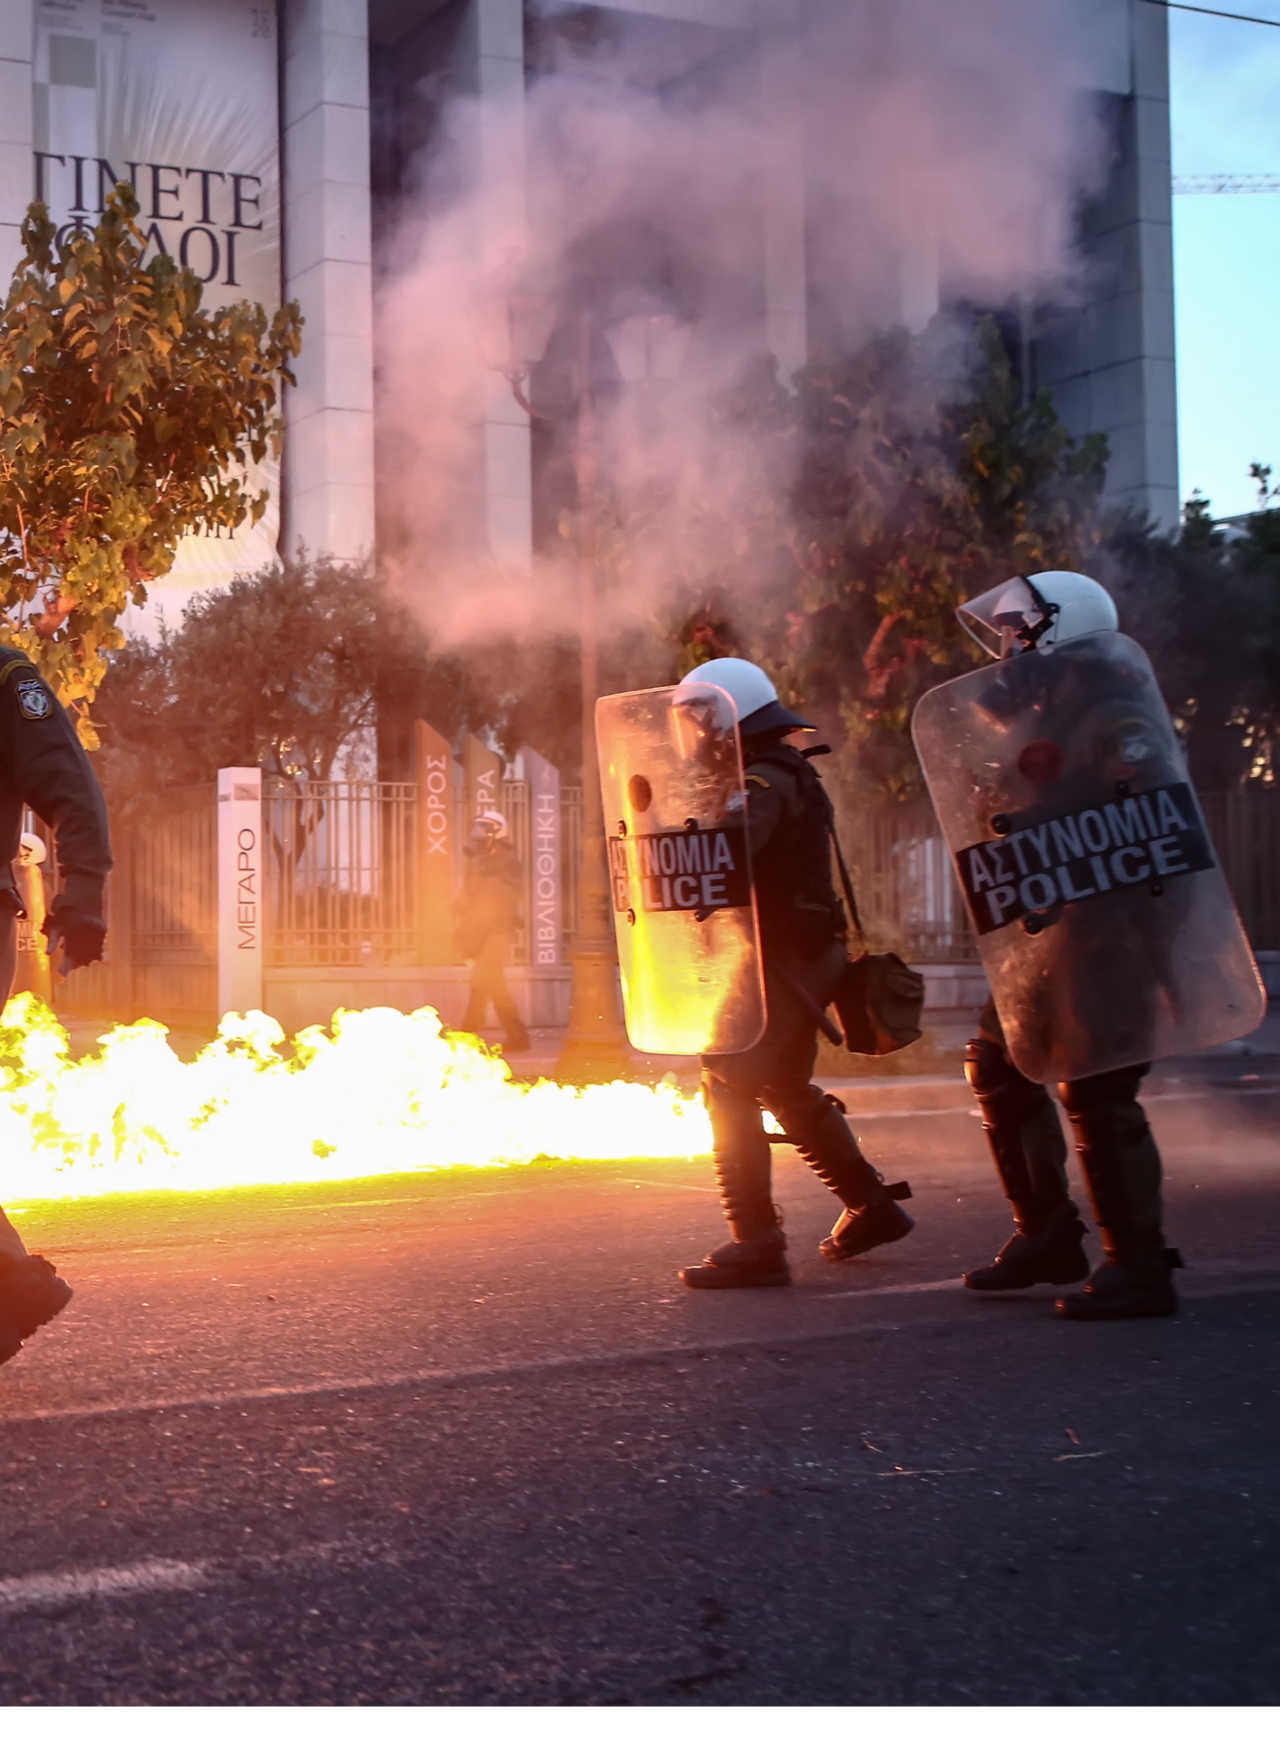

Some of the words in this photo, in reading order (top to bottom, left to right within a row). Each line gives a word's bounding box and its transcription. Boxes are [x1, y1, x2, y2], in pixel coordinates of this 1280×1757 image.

[32, 151, 263, 231] ΓΙΝΕΤΕ
[426, 754, 448, 856] ΧΟΡΟΣ
[970, 789, 1192, 893] ΑΣΤΥΝΟΜΙΑ
[238, 828, 256, 950] ΜΕΓΑΡΟ
[536, 794, 556, 965] ΒΙΒΛΙΟΘΗΚΗ
[984, 835, 1191, 926] POLICE
